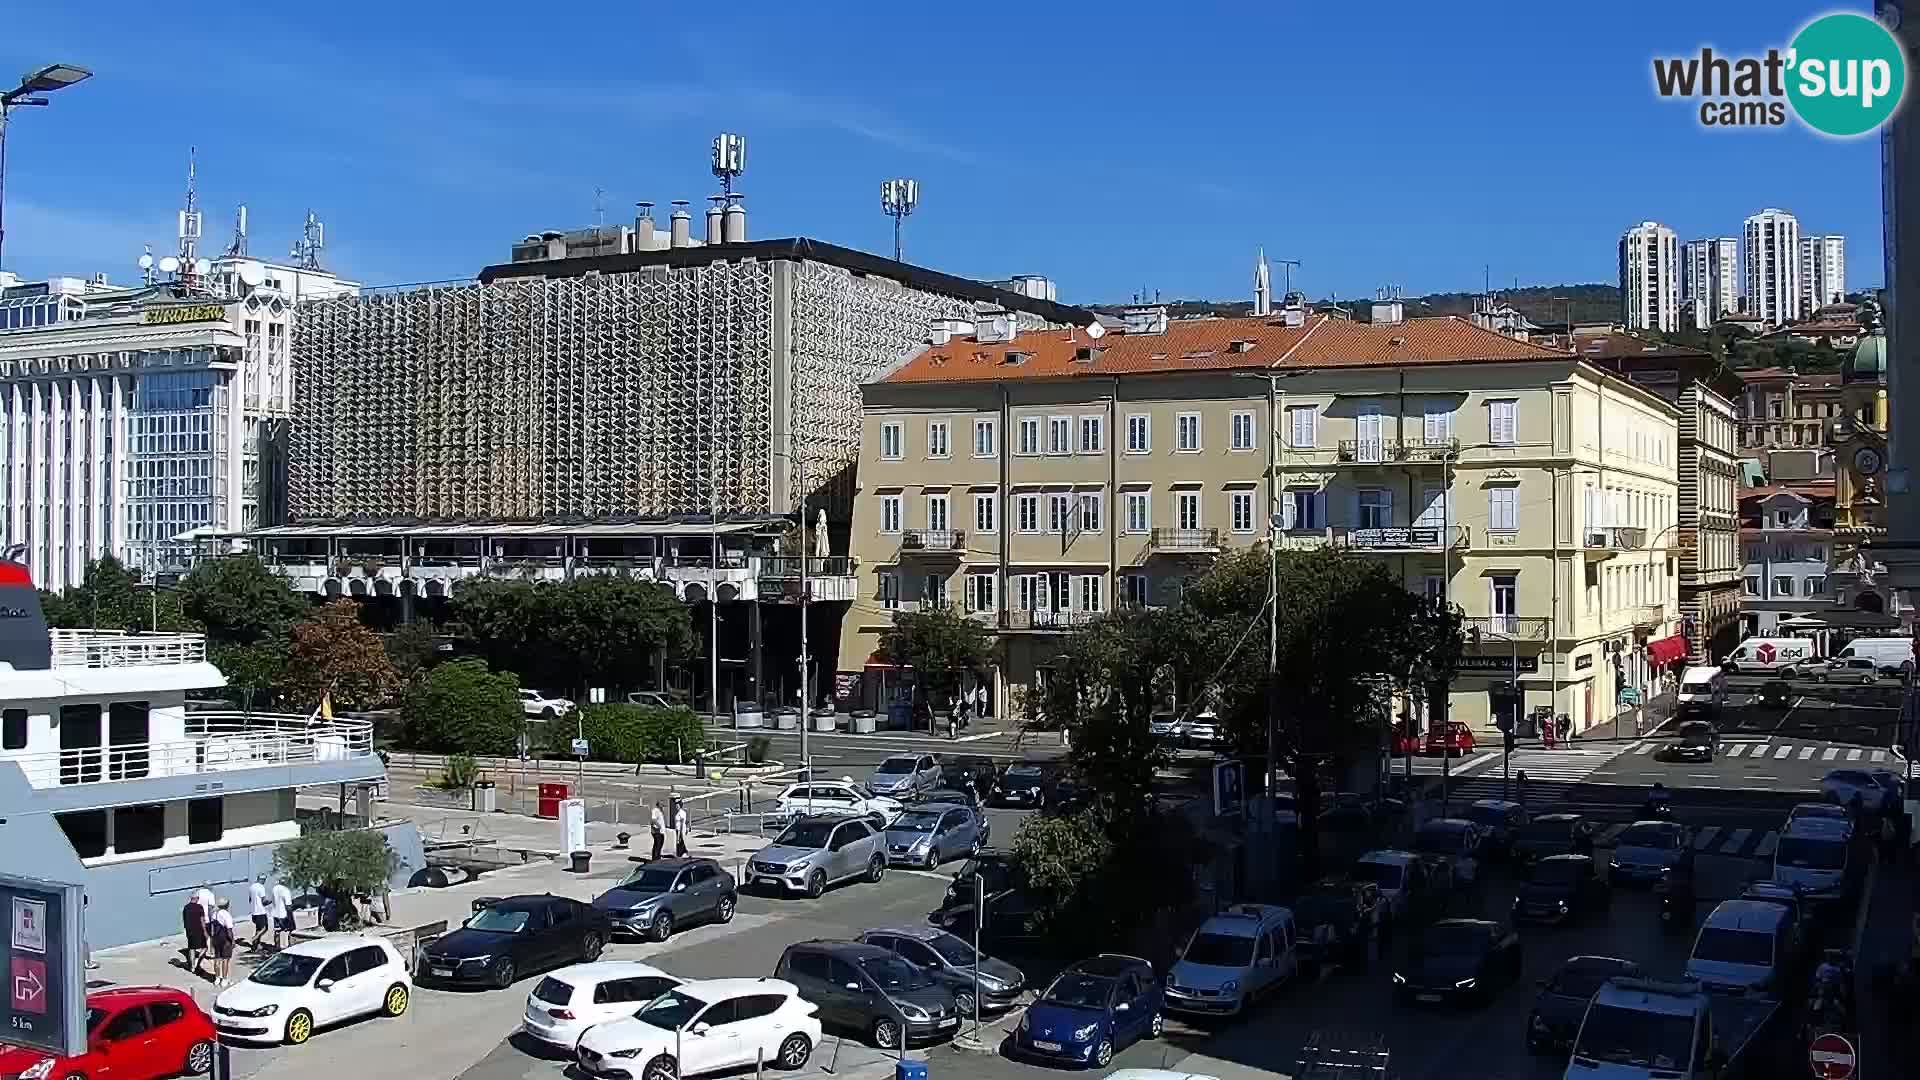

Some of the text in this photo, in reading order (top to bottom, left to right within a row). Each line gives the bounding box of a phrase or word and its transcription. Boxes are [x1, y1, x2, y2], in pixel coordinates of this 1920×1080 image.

[1780, 647, 1803, 661] dpd
[11, 1016, 33, 1031] 5 km
